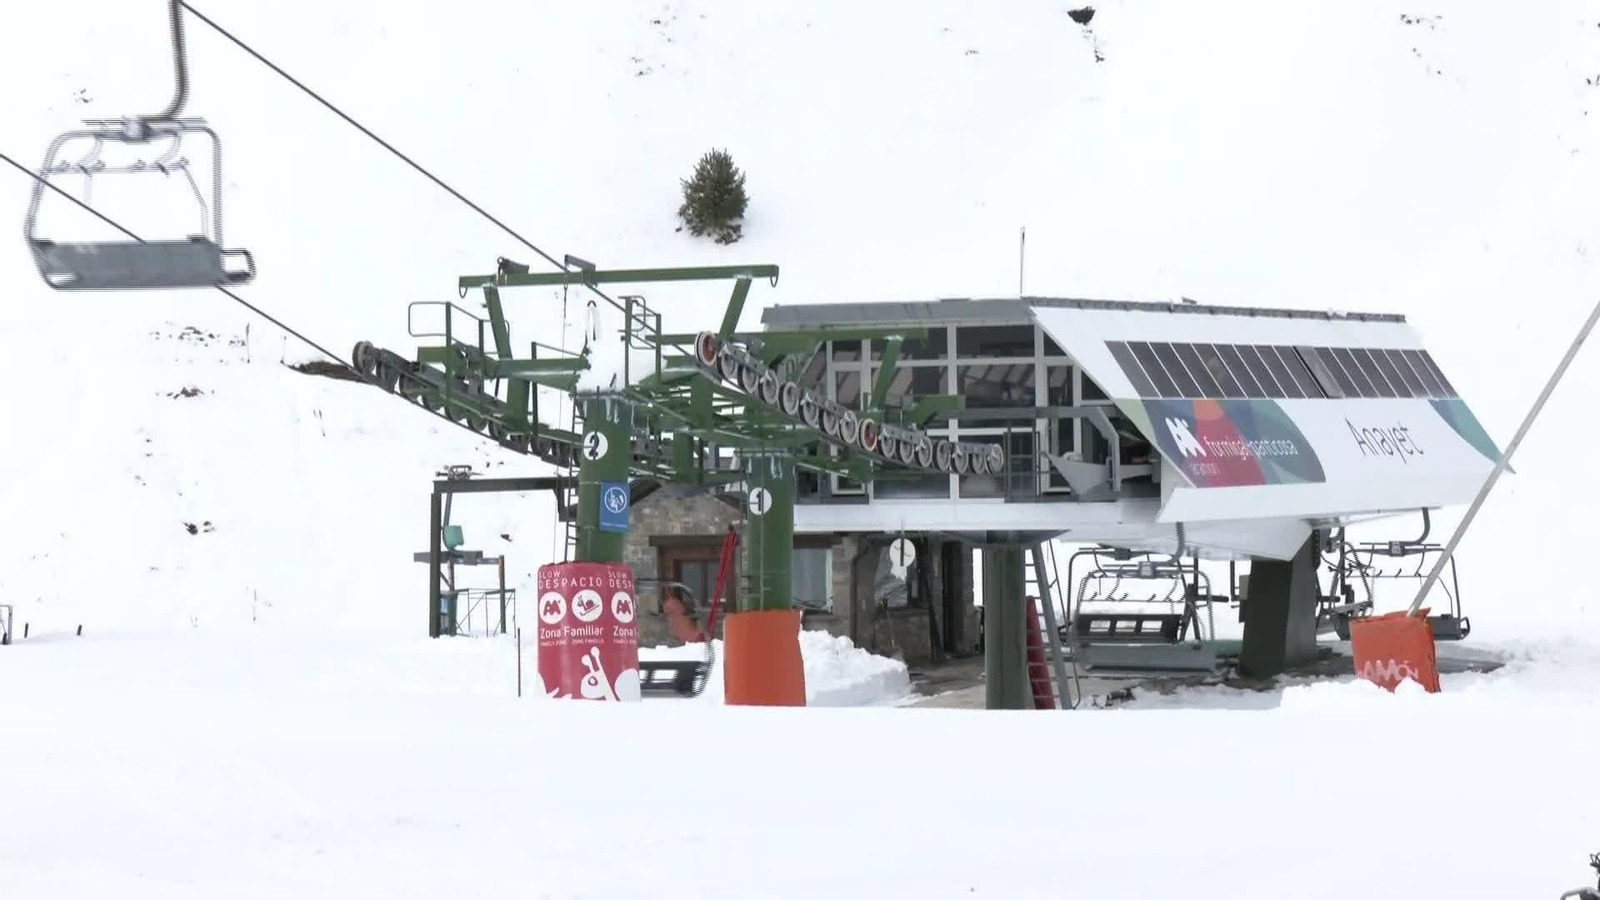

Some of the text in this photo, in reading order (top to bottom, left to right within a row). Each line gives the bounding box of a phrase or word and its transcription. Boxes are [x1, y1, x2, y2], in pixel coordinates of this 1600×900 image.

[588, 434, 599, 458] 2
[1344, 417, 1424, 465] Anayet
[539, 577, 602, 589] DESPACIO
[540, 624, 604, 639] Zona Familiar
[613, 626, 634, 636] Zona
